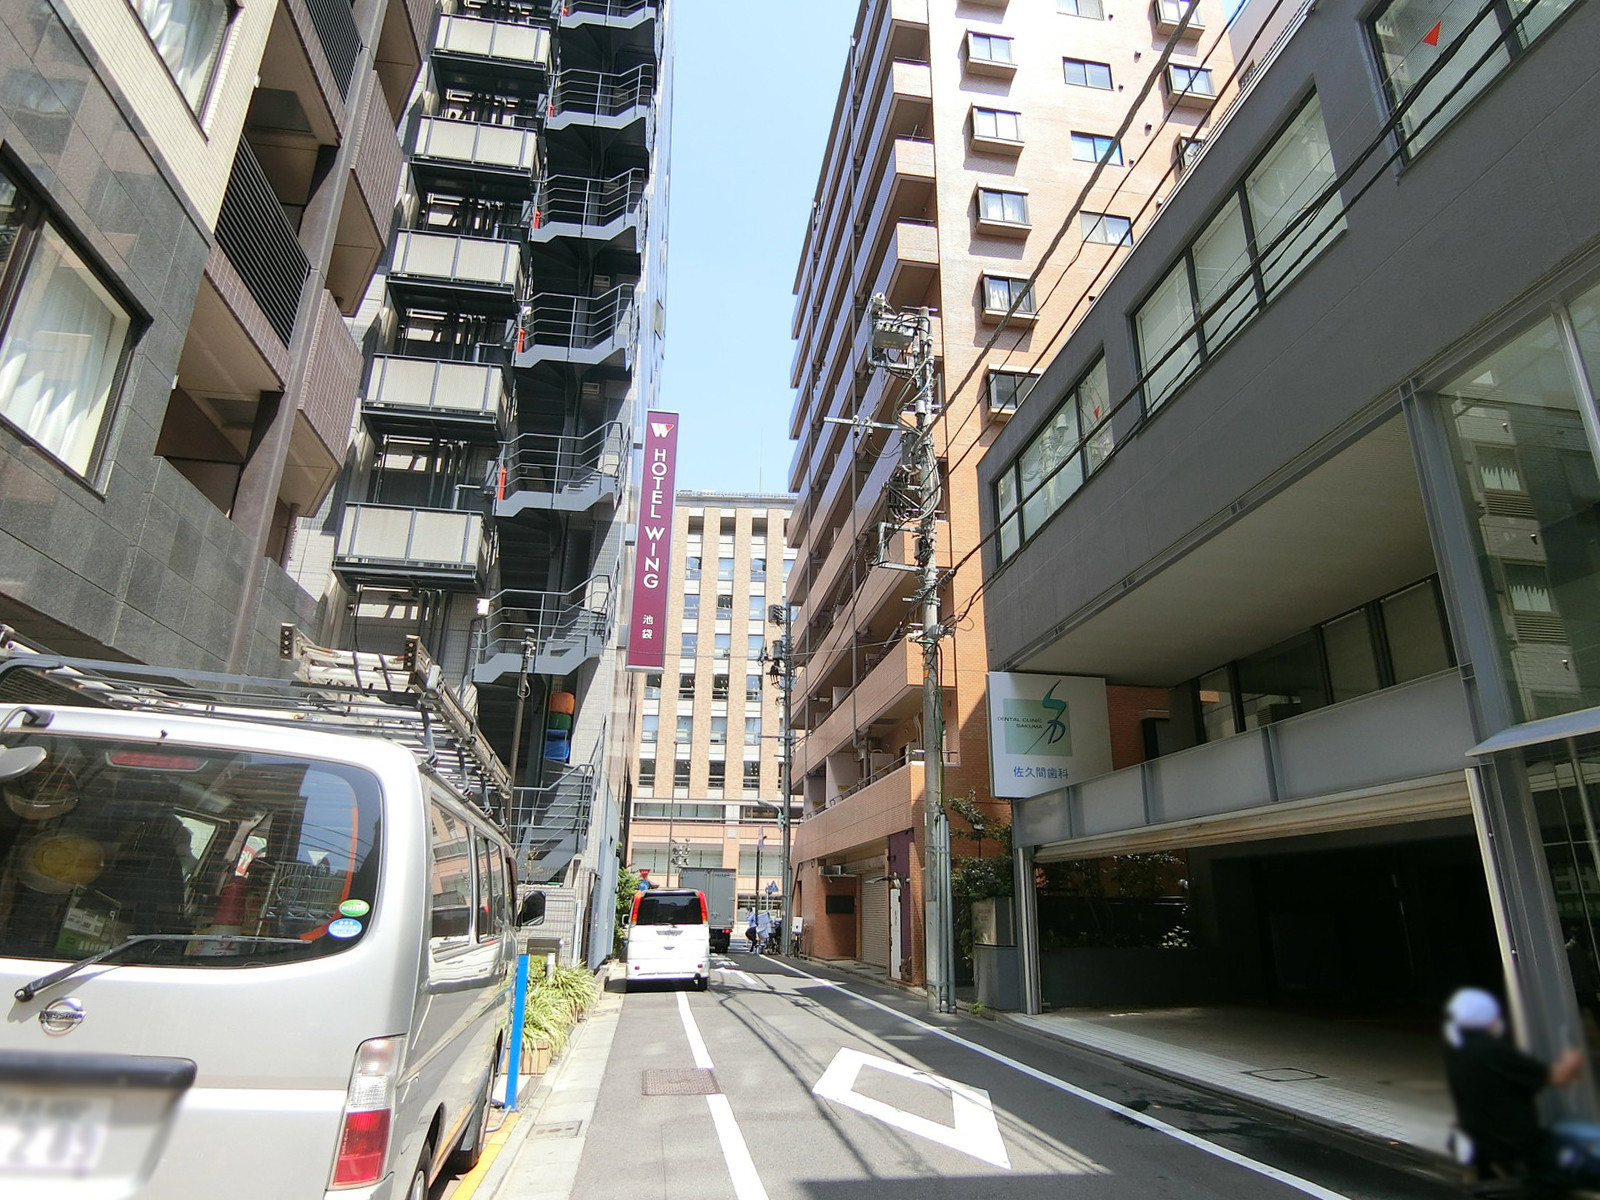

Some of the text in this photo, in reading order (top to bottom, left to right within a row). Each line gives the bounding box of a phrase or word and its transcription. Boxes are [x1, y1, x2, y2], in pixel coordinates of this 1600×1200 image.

[643, 448, 668, 589] HOTEL WING
[641, 614, 654, 640] 池袋
[1013, 765, 1069, 779] 佐久間歯科
